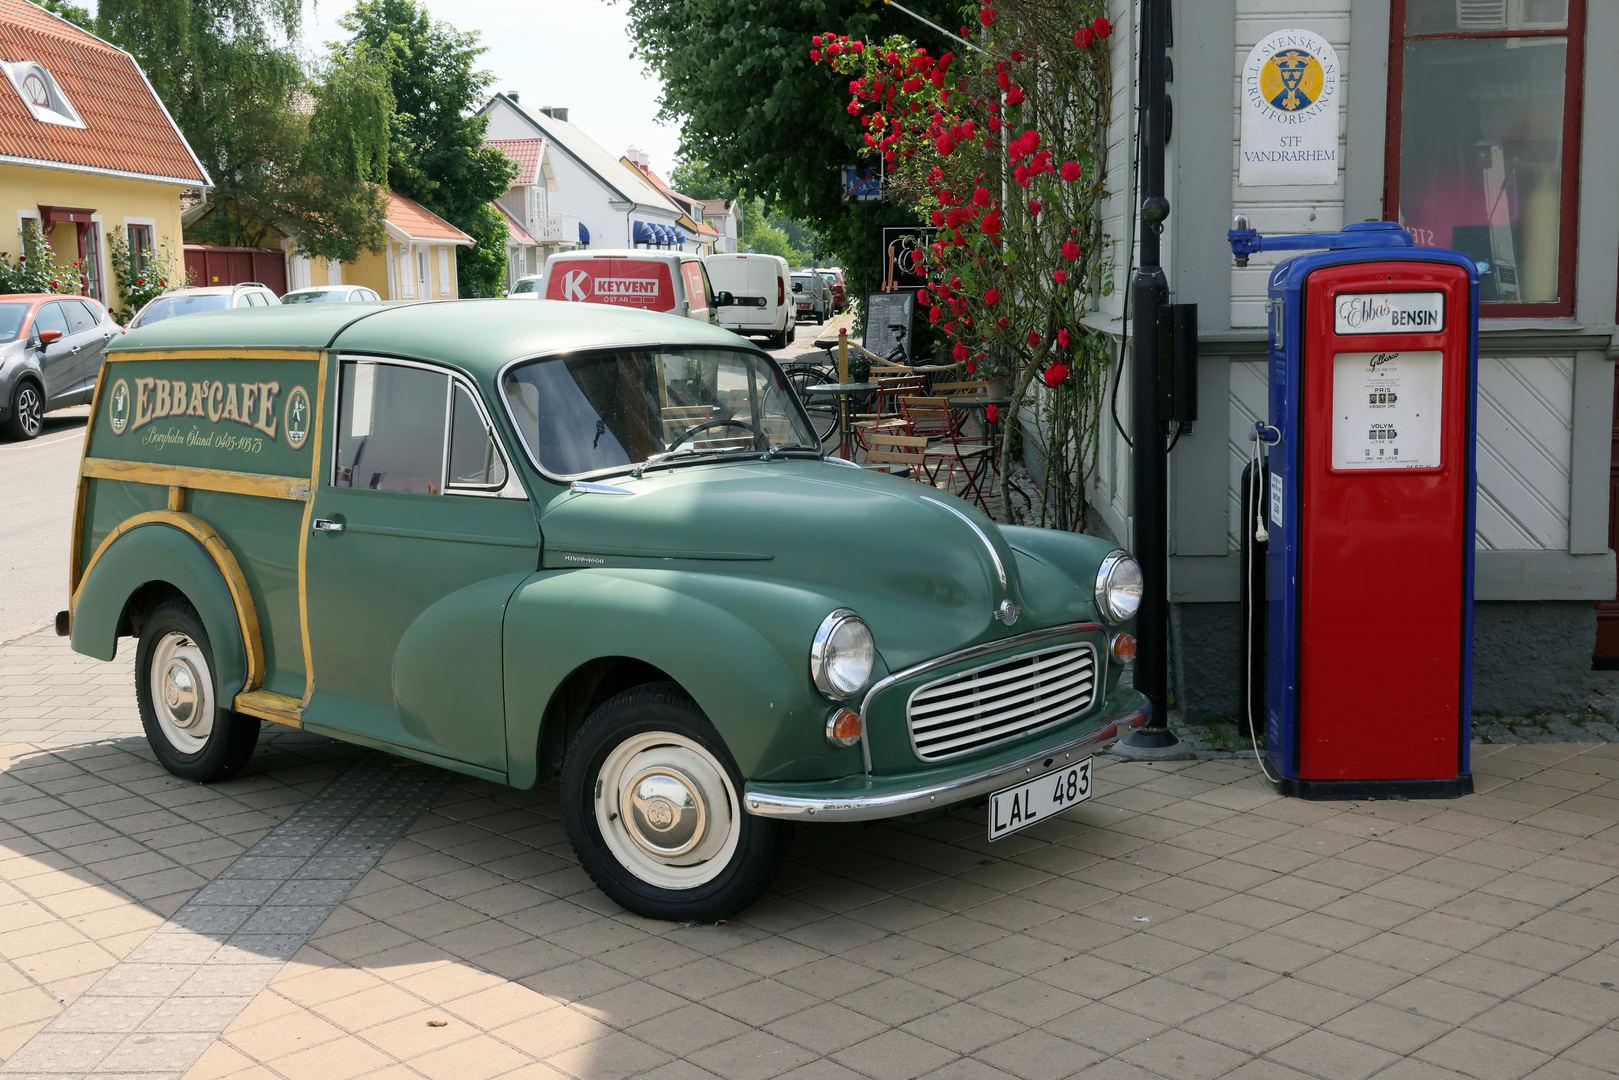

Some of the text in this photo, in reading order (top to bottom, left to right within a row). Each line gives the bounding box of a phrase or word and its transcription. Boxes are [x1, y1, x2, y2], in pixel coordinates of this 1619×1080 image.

[1262, 35, 1322, 56] SVENSKA
[1247, 64, 1335, 125] TURISTFÖRENINGEN
[1280, 136, 1302, 147] STF
[1244, 150, 1335, 161] VANDRARHEM
[565, 270, 588, 301] K
[598, 280, 656, 293] KEYVENT
[1391, 310, 1438, 326] BENSIN
[207, 380, 280, 438] CAFE
[141, 425, 184, 451] Borgholm
[186, 425, 214, 447] Öland
[995, 764, 1089, 832] LAL 483
